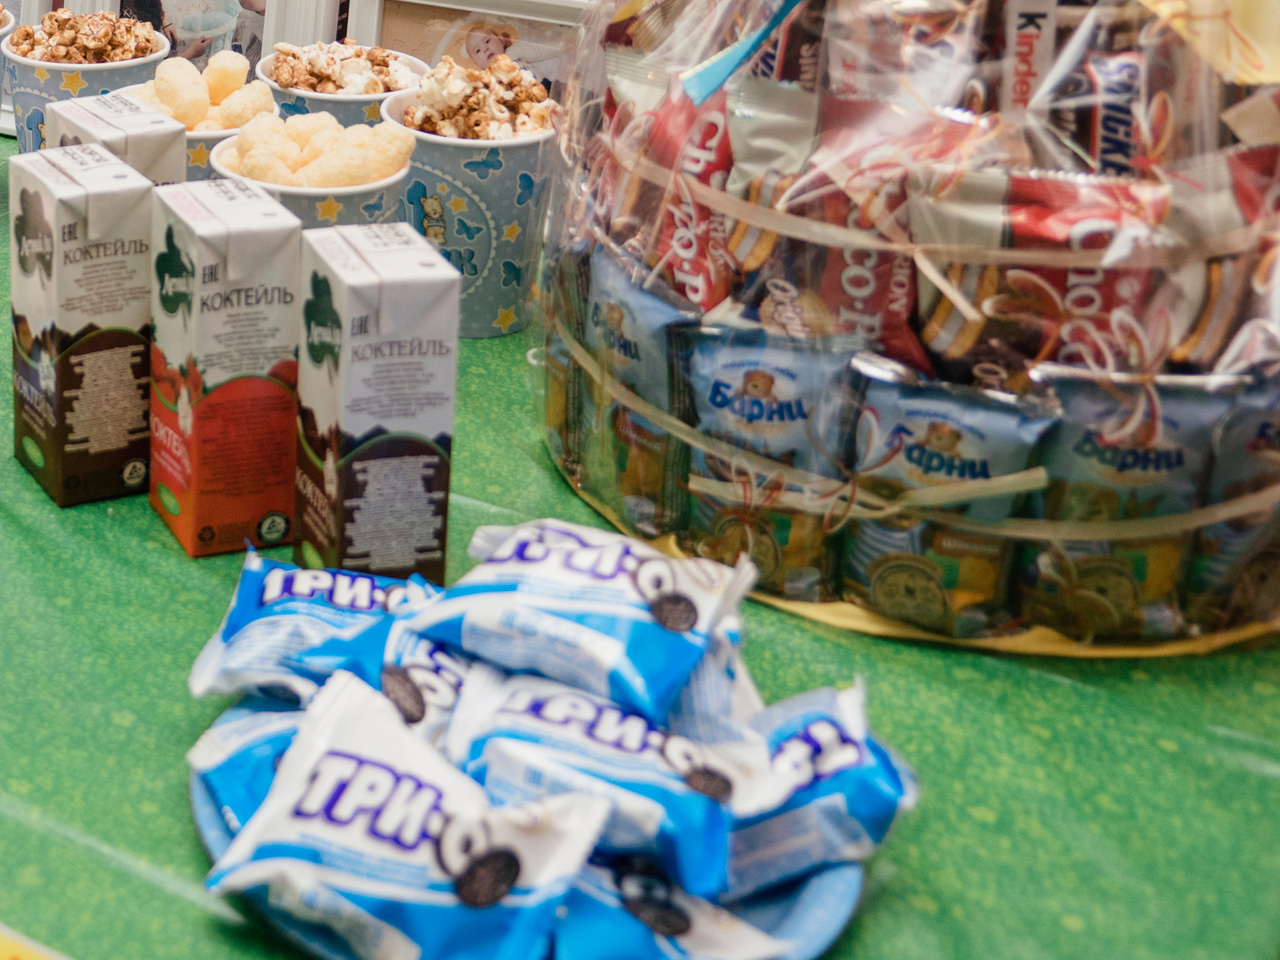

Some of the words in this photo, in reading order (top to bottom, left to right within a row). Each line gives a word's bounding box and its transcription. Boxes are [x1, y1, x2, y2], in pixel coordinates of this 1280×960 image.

[1012, 12, 1047, 108] Kinder
[1096, 58, 1141, 176] SNICKE
[63, 238, 149, 265] КОКТЕЙЛЬ
[200, 284, 294, 313] КОКТЕЙЛЬ
[350, 336, 450, 363] КОКТЕЙЛЬ
[708, 378, 808, 423] Барни
